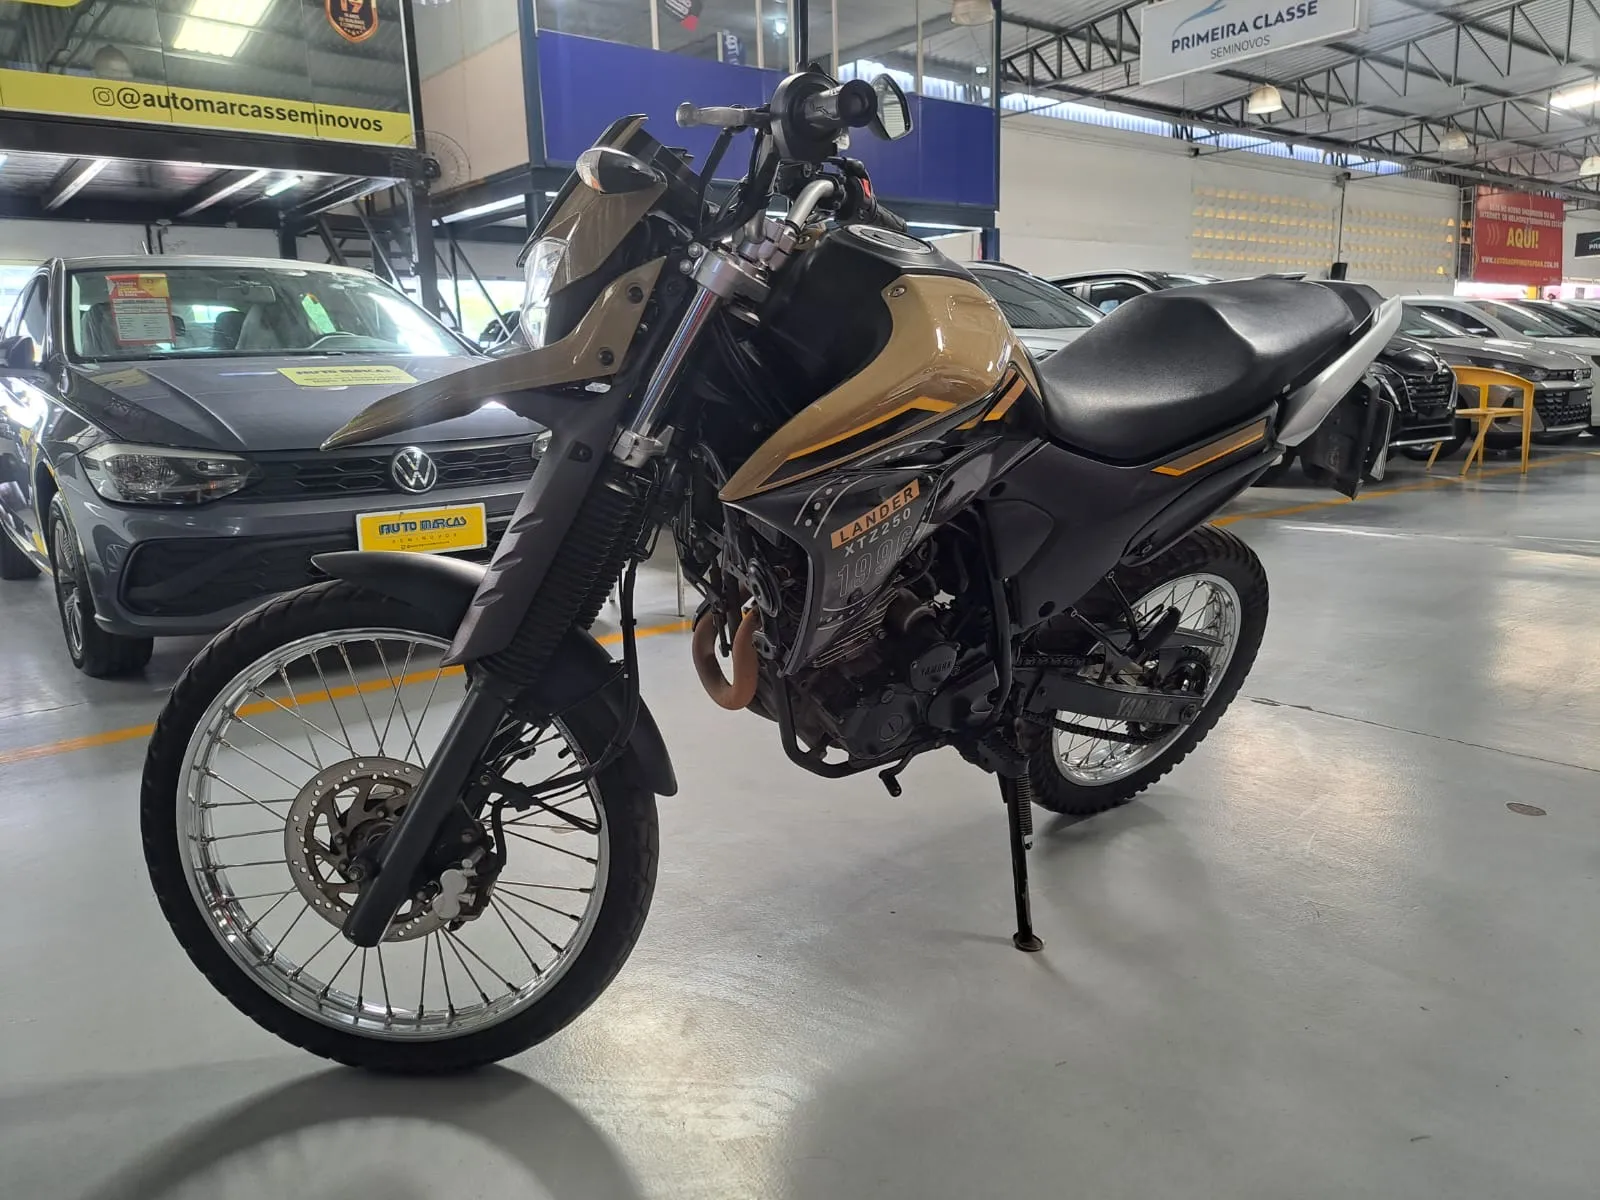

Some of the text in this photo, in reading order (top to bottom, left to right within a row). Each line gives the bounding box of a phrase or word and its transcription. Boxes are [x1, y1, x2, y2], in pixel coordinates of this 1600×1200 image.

[1171, 0, 1318, 53] PRIMEIRA CLASSE
[1210, 35, 1271, 60] SEMINOVOS
[117, 87, 383, 132] @automarcasseminovos
[1506, 227, 1539, 249] AQUI!
[379, 516, 467, 535] AUTO MARCAS
[840, 487, 915, 543] LANDER
[844, 508, 911, 558] XTZ250
